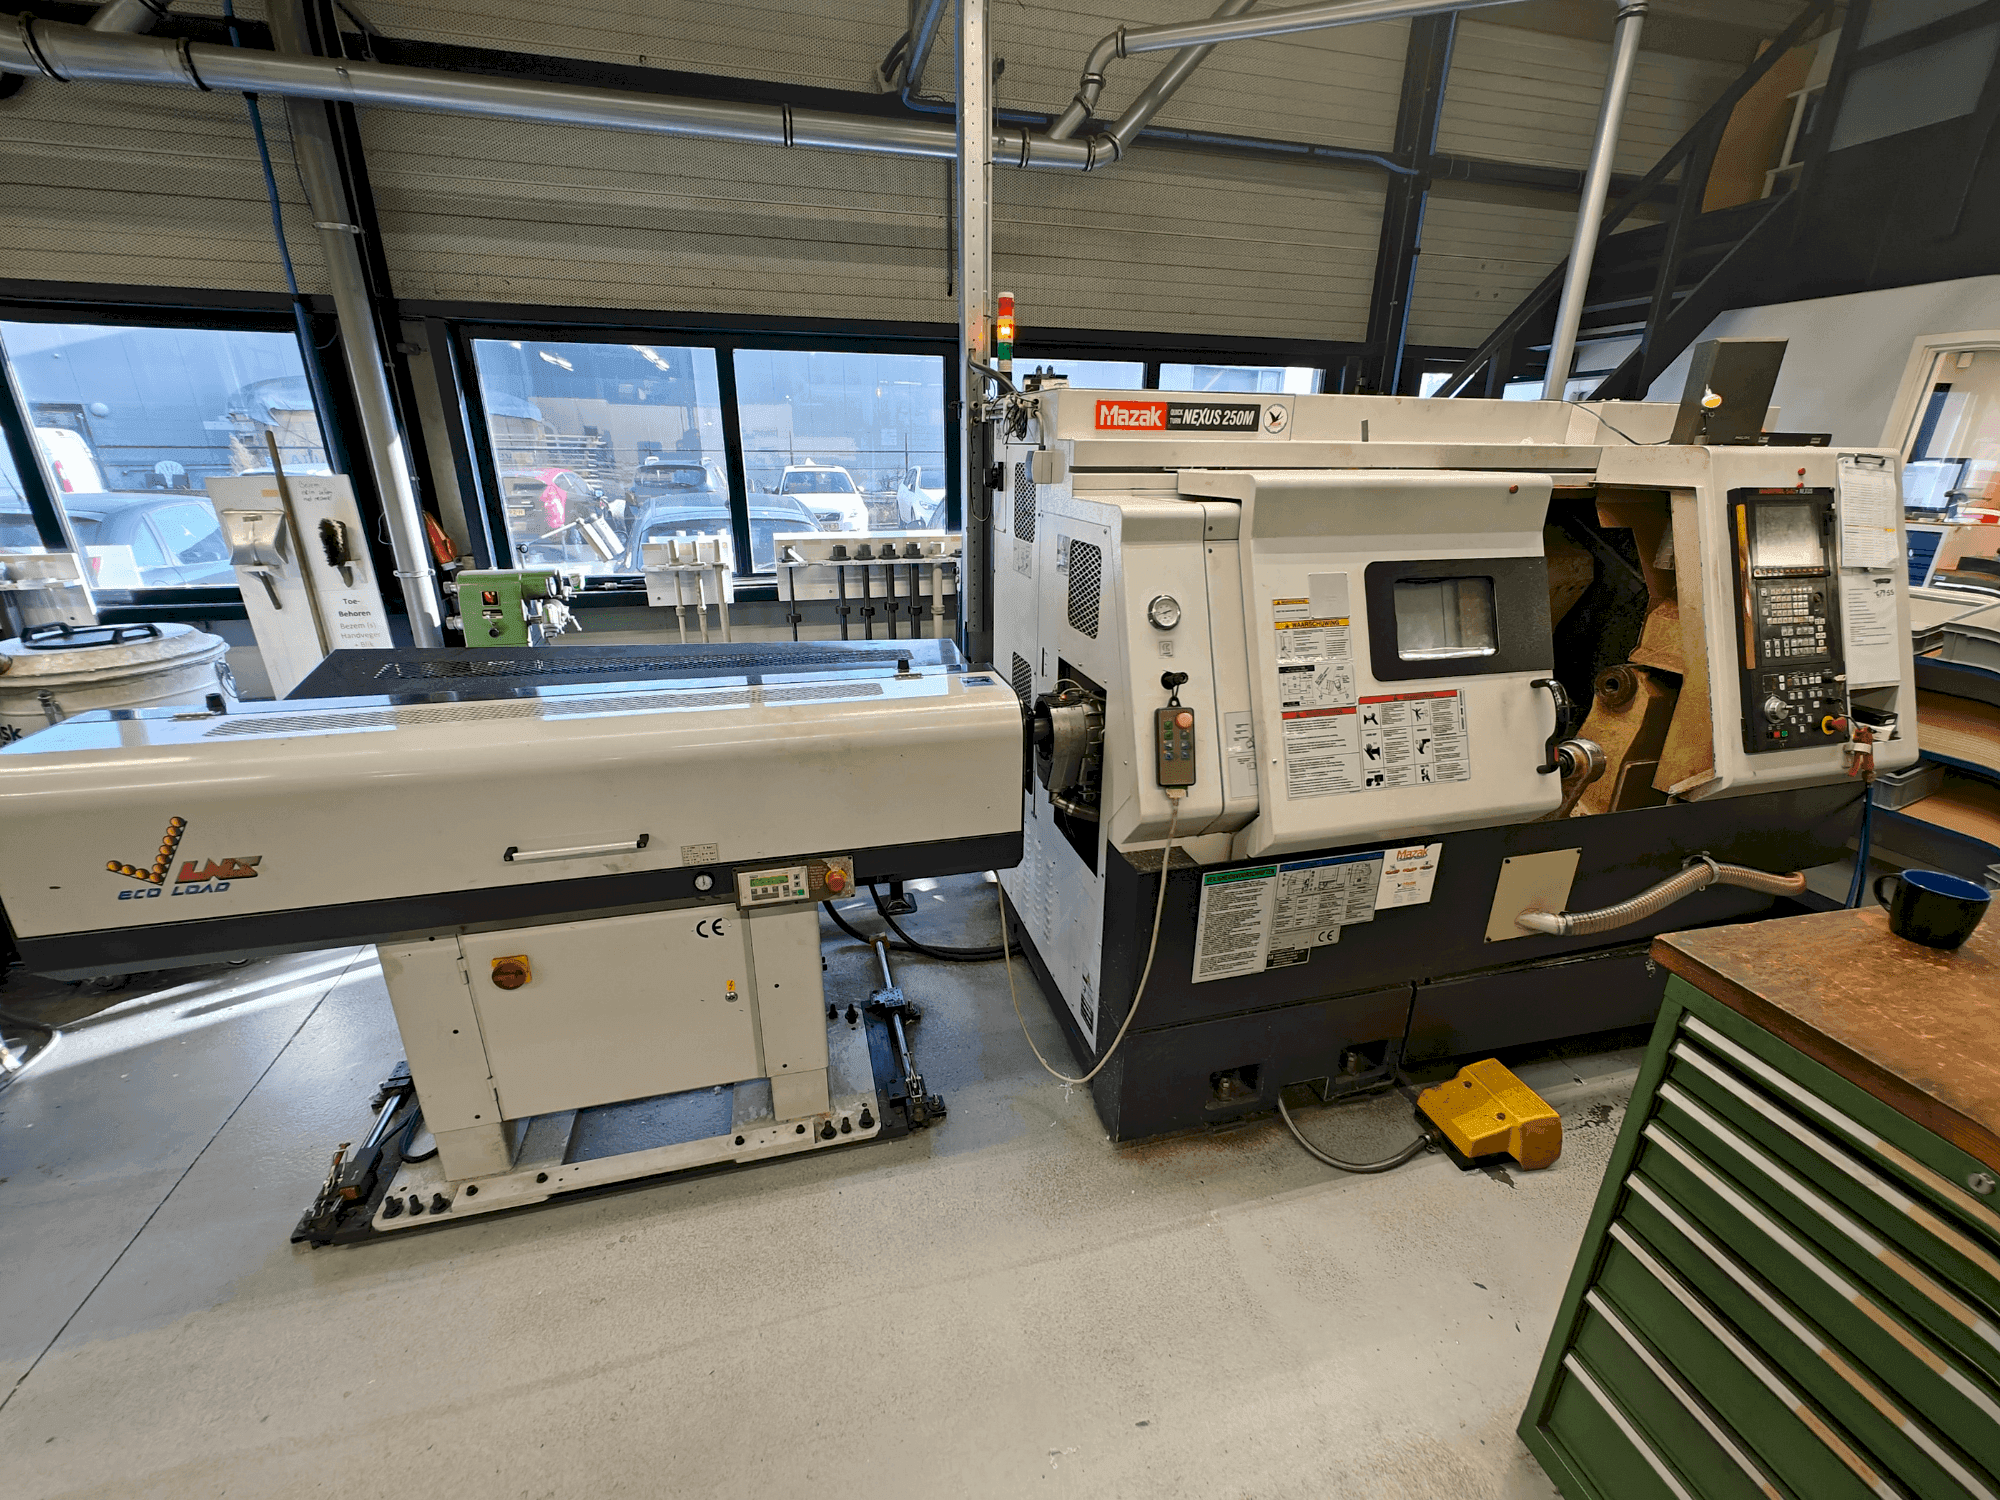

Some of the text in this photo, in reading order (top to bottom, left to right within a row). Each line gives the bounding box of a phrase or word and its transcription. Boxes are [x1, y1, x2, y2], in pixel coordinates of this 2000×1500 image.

[1100, 404, 1255, 426] Mazak NEXUS 250M
[1170, 408, 1183, 416] QUICK
[1169, 417, 1181, 425] TURN
[341, 632, 381, 640] Handveger
[0, 723, 23, 742] sk
[1396, 848, 1428, 861] Mazak
[174, 855, 263, 884] LNS
[117, 881, 231, 900] ECO LOAD
